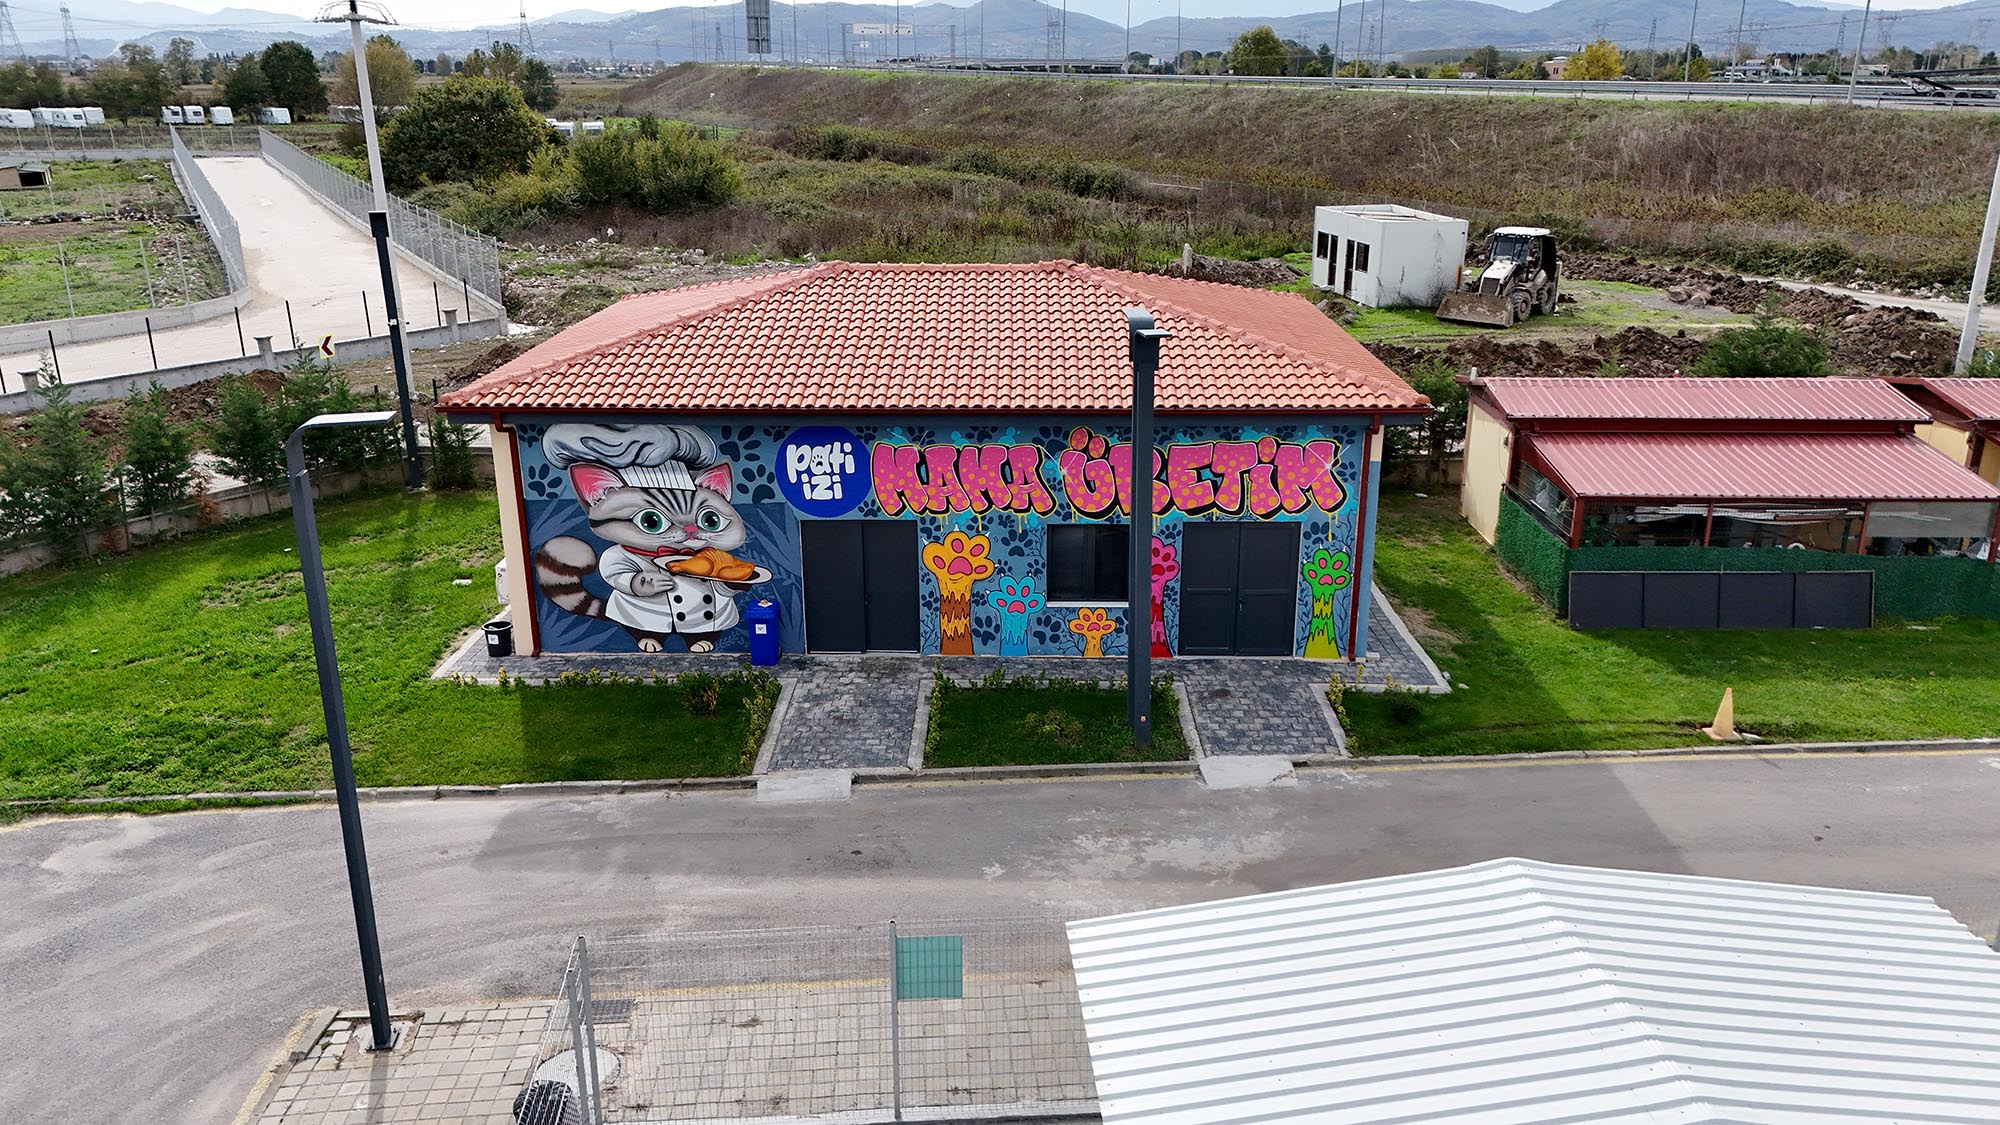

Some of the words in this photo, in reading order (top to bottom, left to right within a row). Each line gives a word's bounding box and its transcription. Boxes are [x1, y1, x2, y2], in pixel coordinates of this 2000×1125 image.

[786, 441, 855, 484] pati
[871, 442, 1056, 516] MAMA
[801, 473, 843, 500] izi
